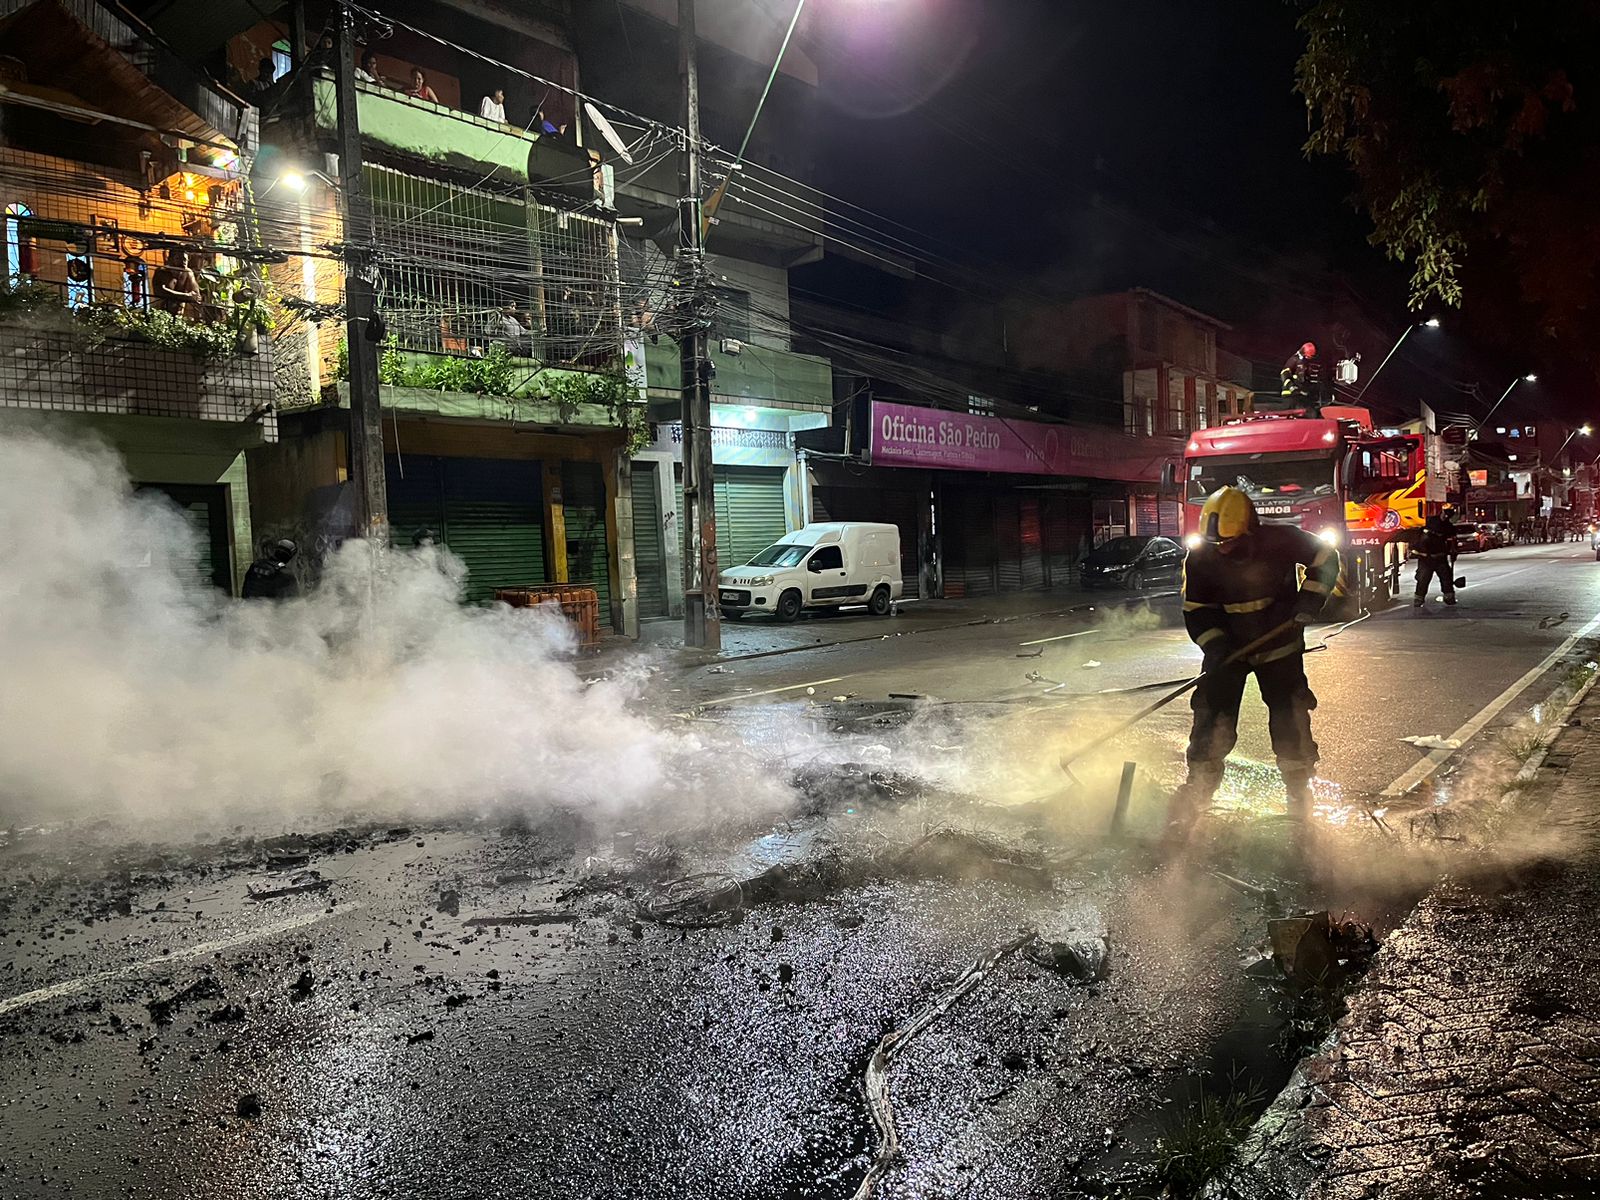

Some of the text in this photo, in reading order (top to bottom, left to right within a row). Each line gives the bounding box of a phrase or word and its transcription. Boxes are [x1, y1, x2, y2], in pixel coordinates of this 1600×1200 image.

[882, 415, 1000, 449] Oficina São Pedro
[1351, 538, 1380, 546] ABT-41
